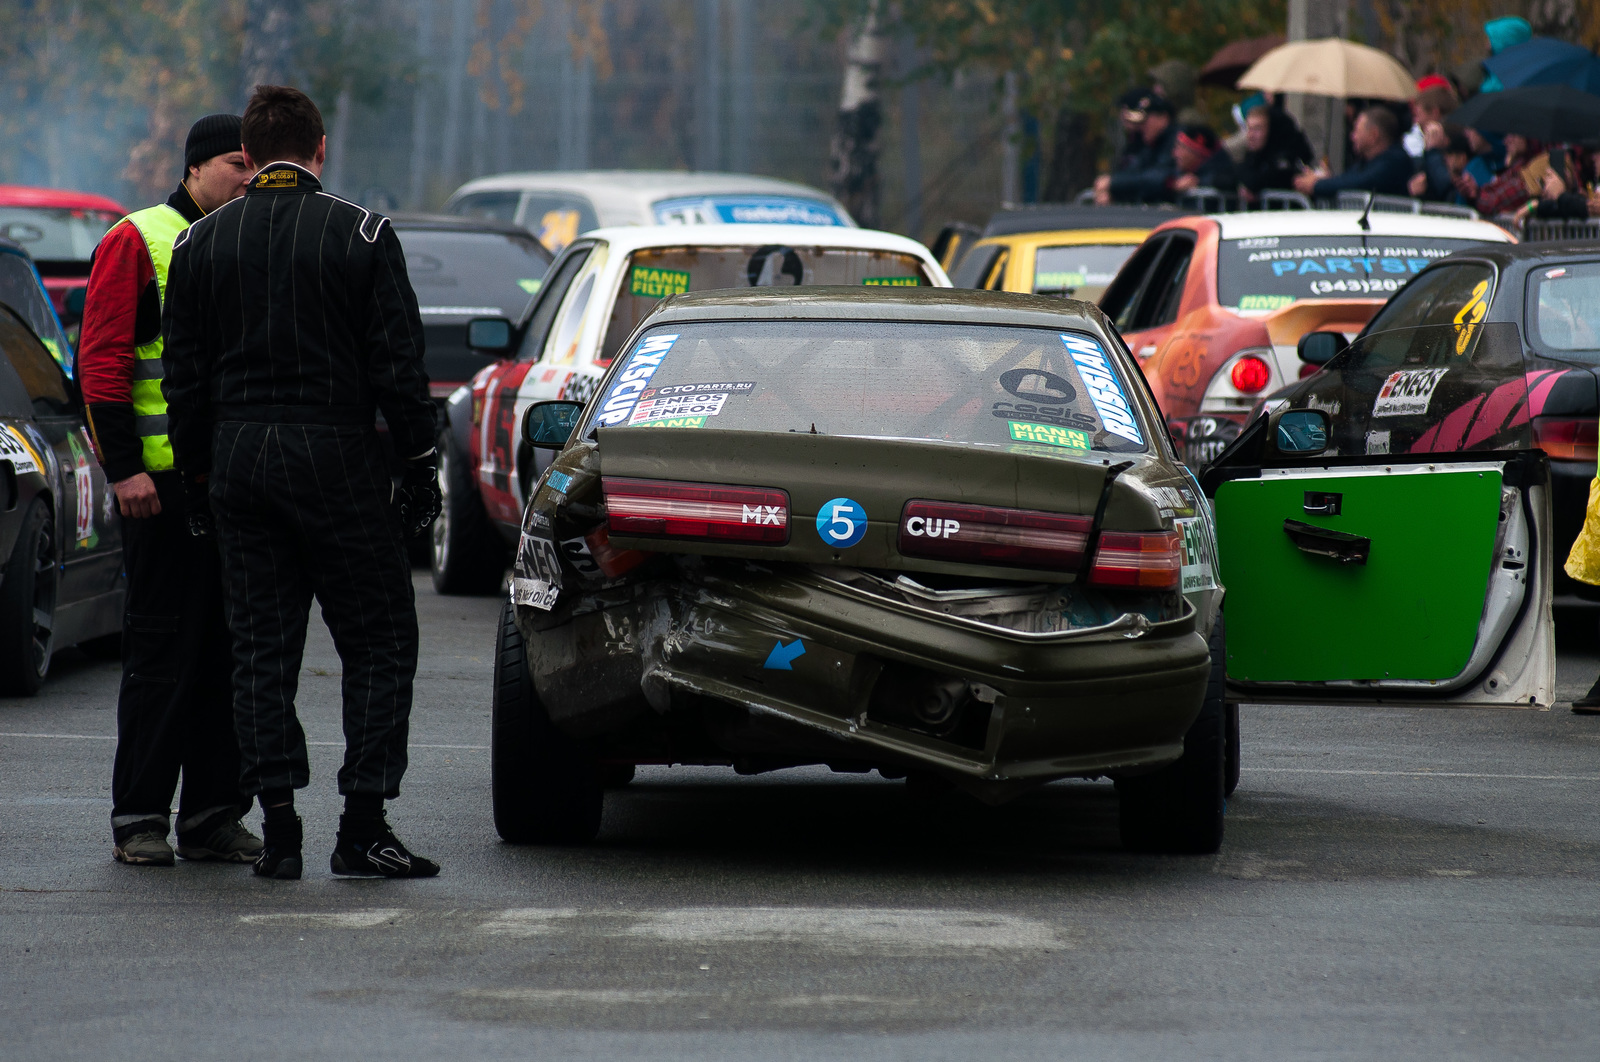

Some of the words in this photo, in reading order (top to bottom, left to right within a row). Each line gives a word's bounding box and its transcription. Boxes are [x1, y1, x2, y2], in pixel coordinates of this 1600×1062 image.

[634, 269, 687, 286] MANN
[632, 281, 686, 296] FILTER
[1060, 335, 1145, 445] RUSSIAN
[1389, 369, 1442, 397] ENEOS
[654, 394, 723, 407] ENEOS
[648, 404, 718, 418] ENEOS
[1013, 423, 1085, 441] MANN
[1015, 431, 1087, 449] FILTER
[742, 504, 780, 526] MX
[828, 505, 855, 530] 5
[906, 516, 961, 539] CUP
